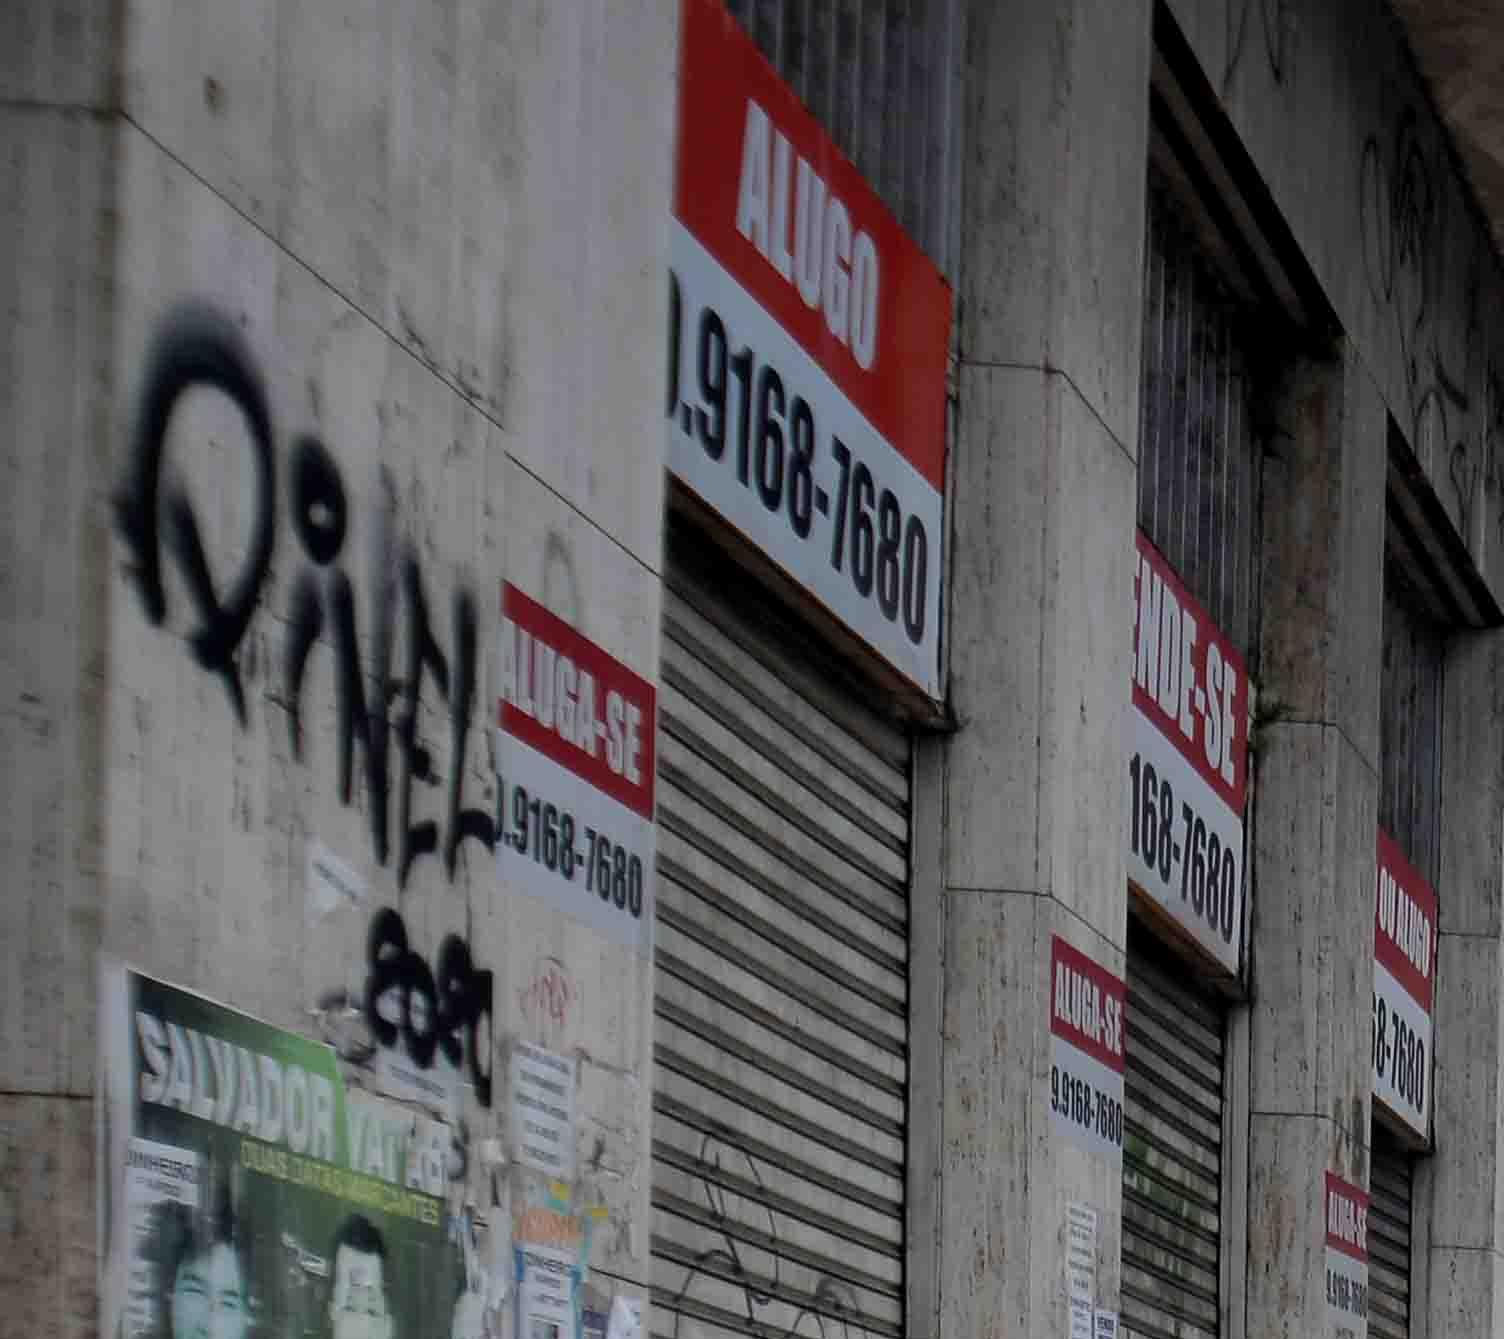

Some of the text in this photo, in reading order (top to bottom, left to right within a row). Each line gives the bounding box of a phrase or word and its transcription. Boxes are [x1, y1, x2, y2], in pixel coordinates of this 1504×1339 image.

[735, 97, 880, 372] ALUGO
[502, 615, 642, 788] ALUGA-SE
[1134, 549, 1237, 789] NDE-SE
[135, 1008, 337, 1163] SALVADOR
[1054, 959, 1122, 1057] ALUGA-SE
[1371, 991, 1424, 1114] 8-7680
[1052, 1065, 1122, 1147] 9.9168-7680
